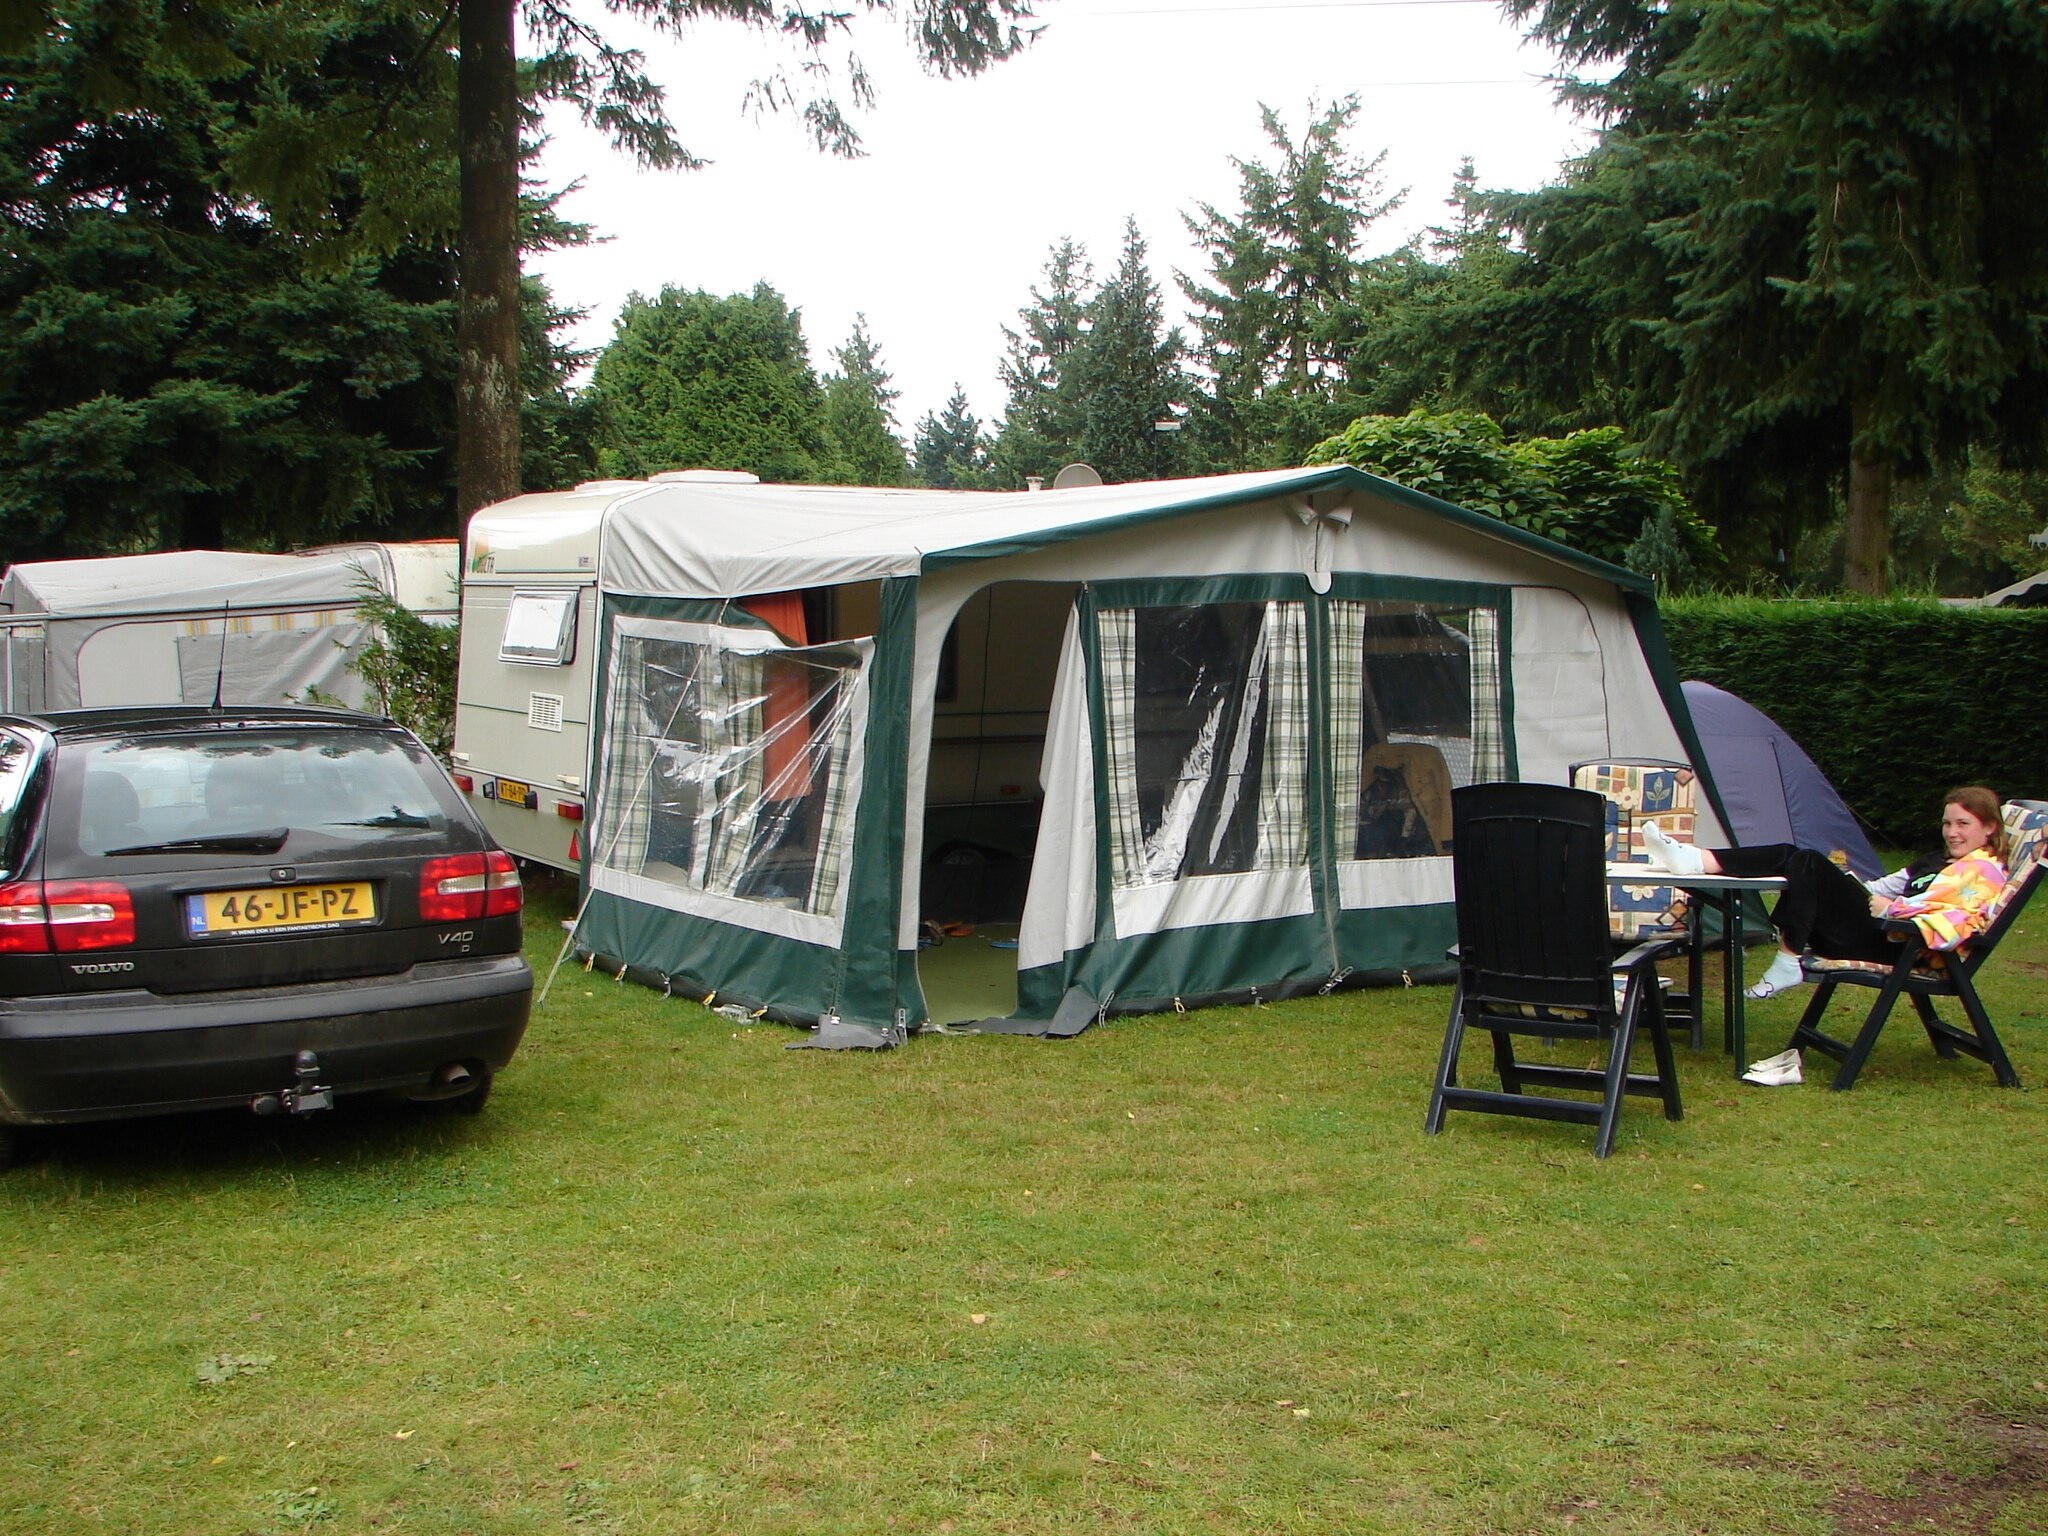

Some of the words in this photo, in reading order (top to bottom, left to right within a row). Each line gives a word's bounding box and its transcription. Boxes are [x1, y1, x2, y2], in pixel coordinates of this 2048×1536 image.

[222, 888, 359, 923] 46-JF-PZ
[192, 916, 206, 926] NL
[438, 930, 474, 944] V40
[461, 944, 470, 953] D
[71, 961, 135, 974] VOLVO
